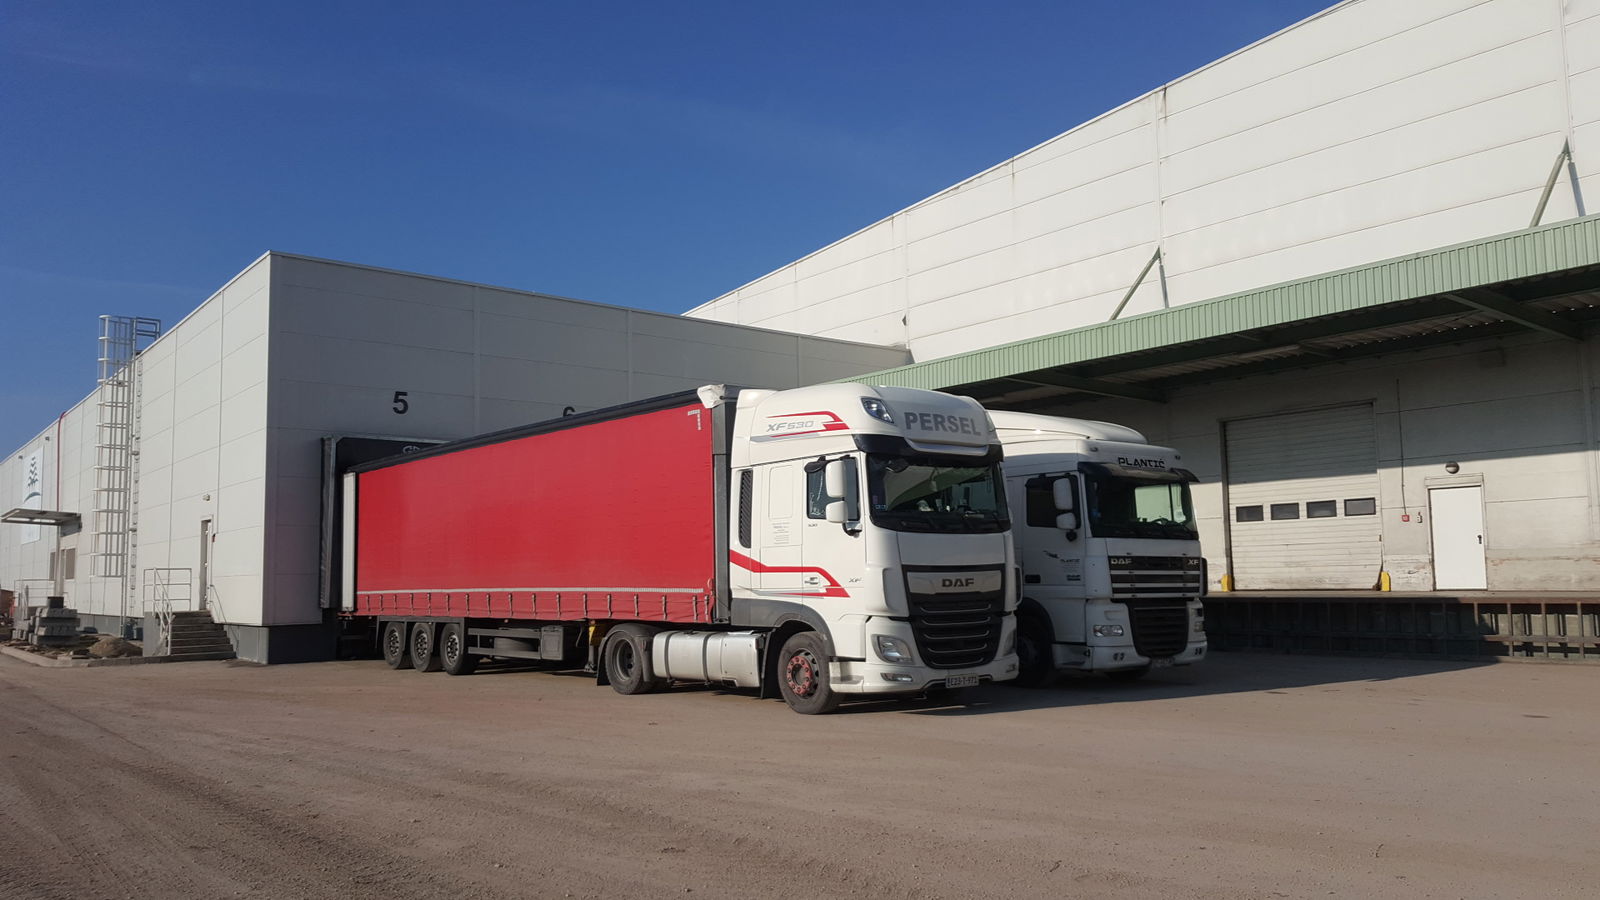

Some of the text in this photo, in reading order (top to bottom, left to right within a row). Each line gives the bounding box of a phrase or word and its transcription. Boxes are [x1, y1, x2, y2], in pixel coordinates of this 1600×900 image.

[392, 391, 409, 415] 5
[766, 420, 815, 432] XF530
[904, 411, 982, 437] PERSEL
[941, 577, 975, 588] DAF
